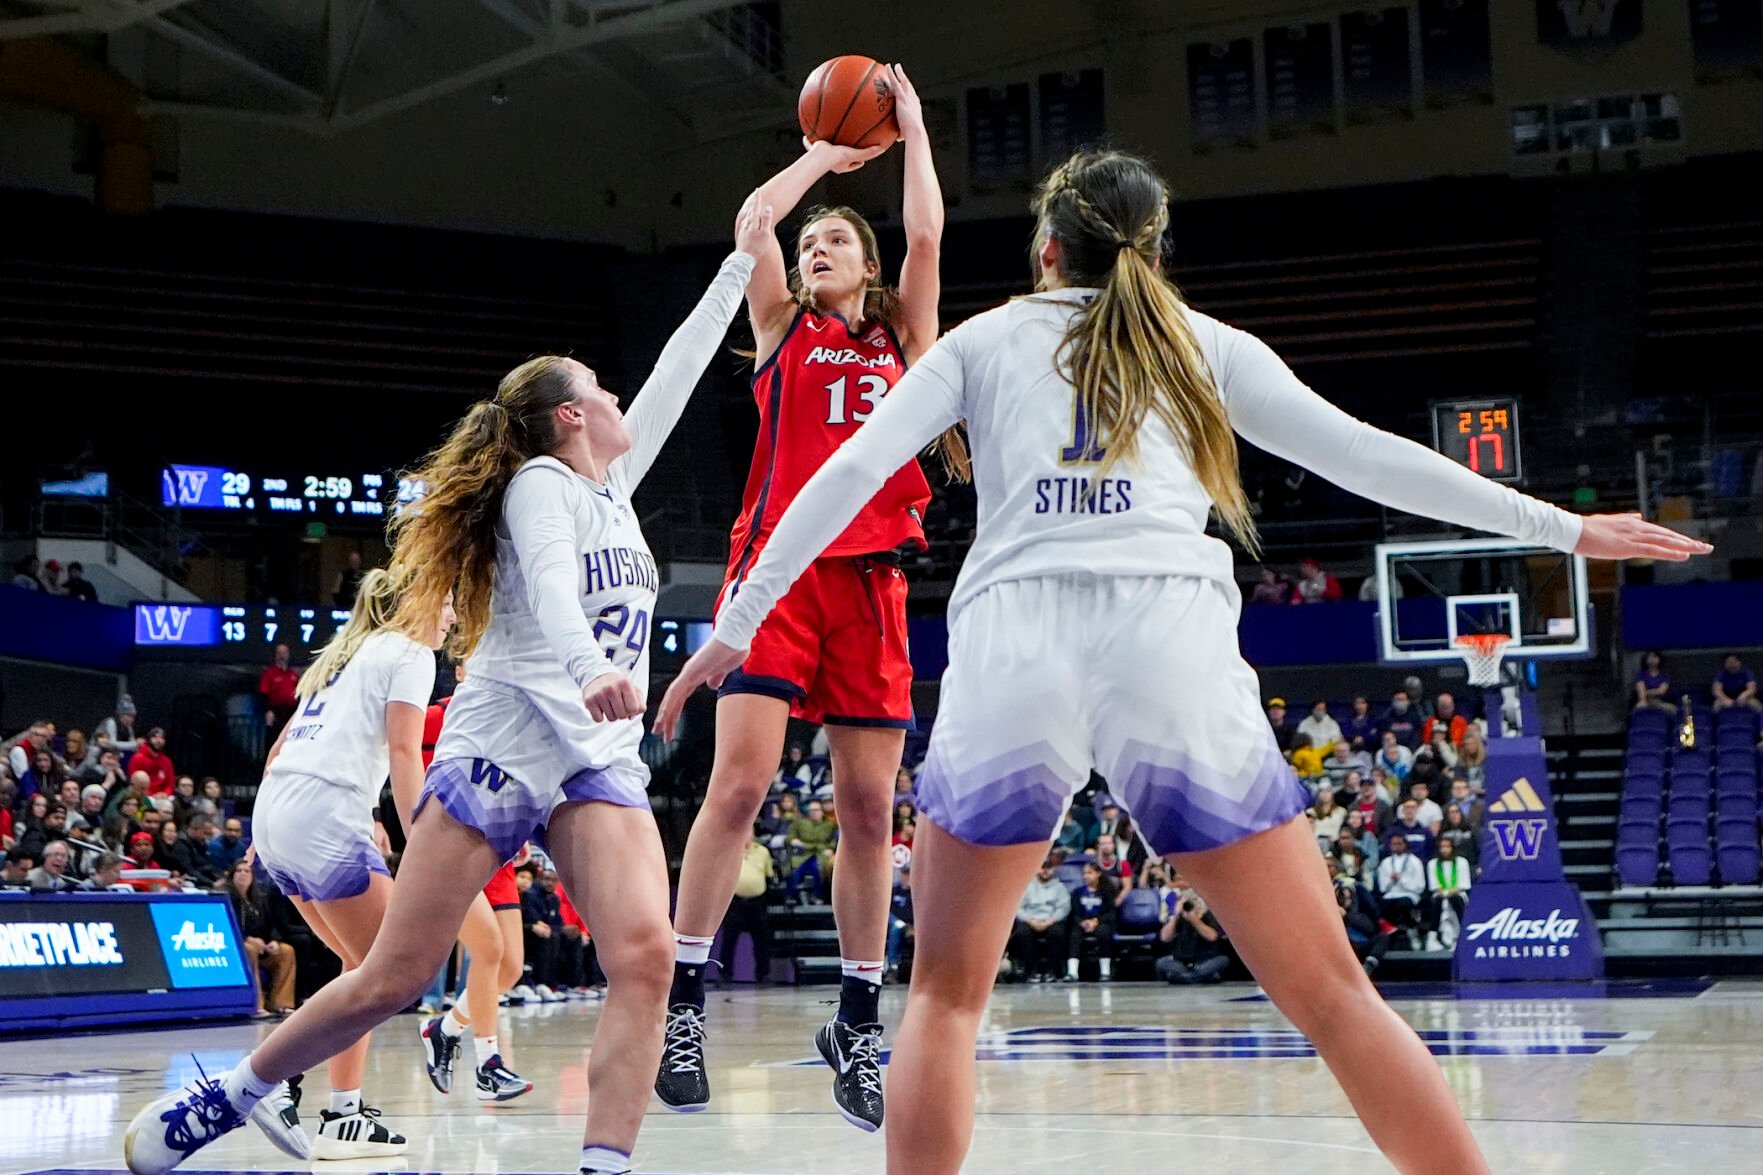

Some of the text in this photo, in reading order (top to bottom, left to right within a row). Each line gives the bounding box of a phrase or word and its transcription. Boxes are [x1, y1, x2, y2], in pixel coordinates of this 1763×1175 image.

[805, 346, 897, 370] ARIZONA
[824, 374, 889, 424] 13
[1469, 433, 1504, 472] 17
[221, 472, 250, 495] 29
[304, 475, 352, 498] 2:59
[309, 500, 316, 511] 1
[1035, 477, 1132, 515] STINES
[141, 605, 192, 640] W
[222, 621, 245, 641] 13
[265, 622, 278, 642] 7
[301, 624, 314, 642] 7
[593, 605, 647, 670] 24
[664, 633, 677, 652] 4
[470, 757, 514, 793] W
[1488, 818, 1548, 860] W
[1466, 907, 1579, 943] Alaska
[171, 920, 226, 955] Alaska
[182, 956, 229, 969] AIRLINES
[1474, 944, 1571, 959] AIRLINES
